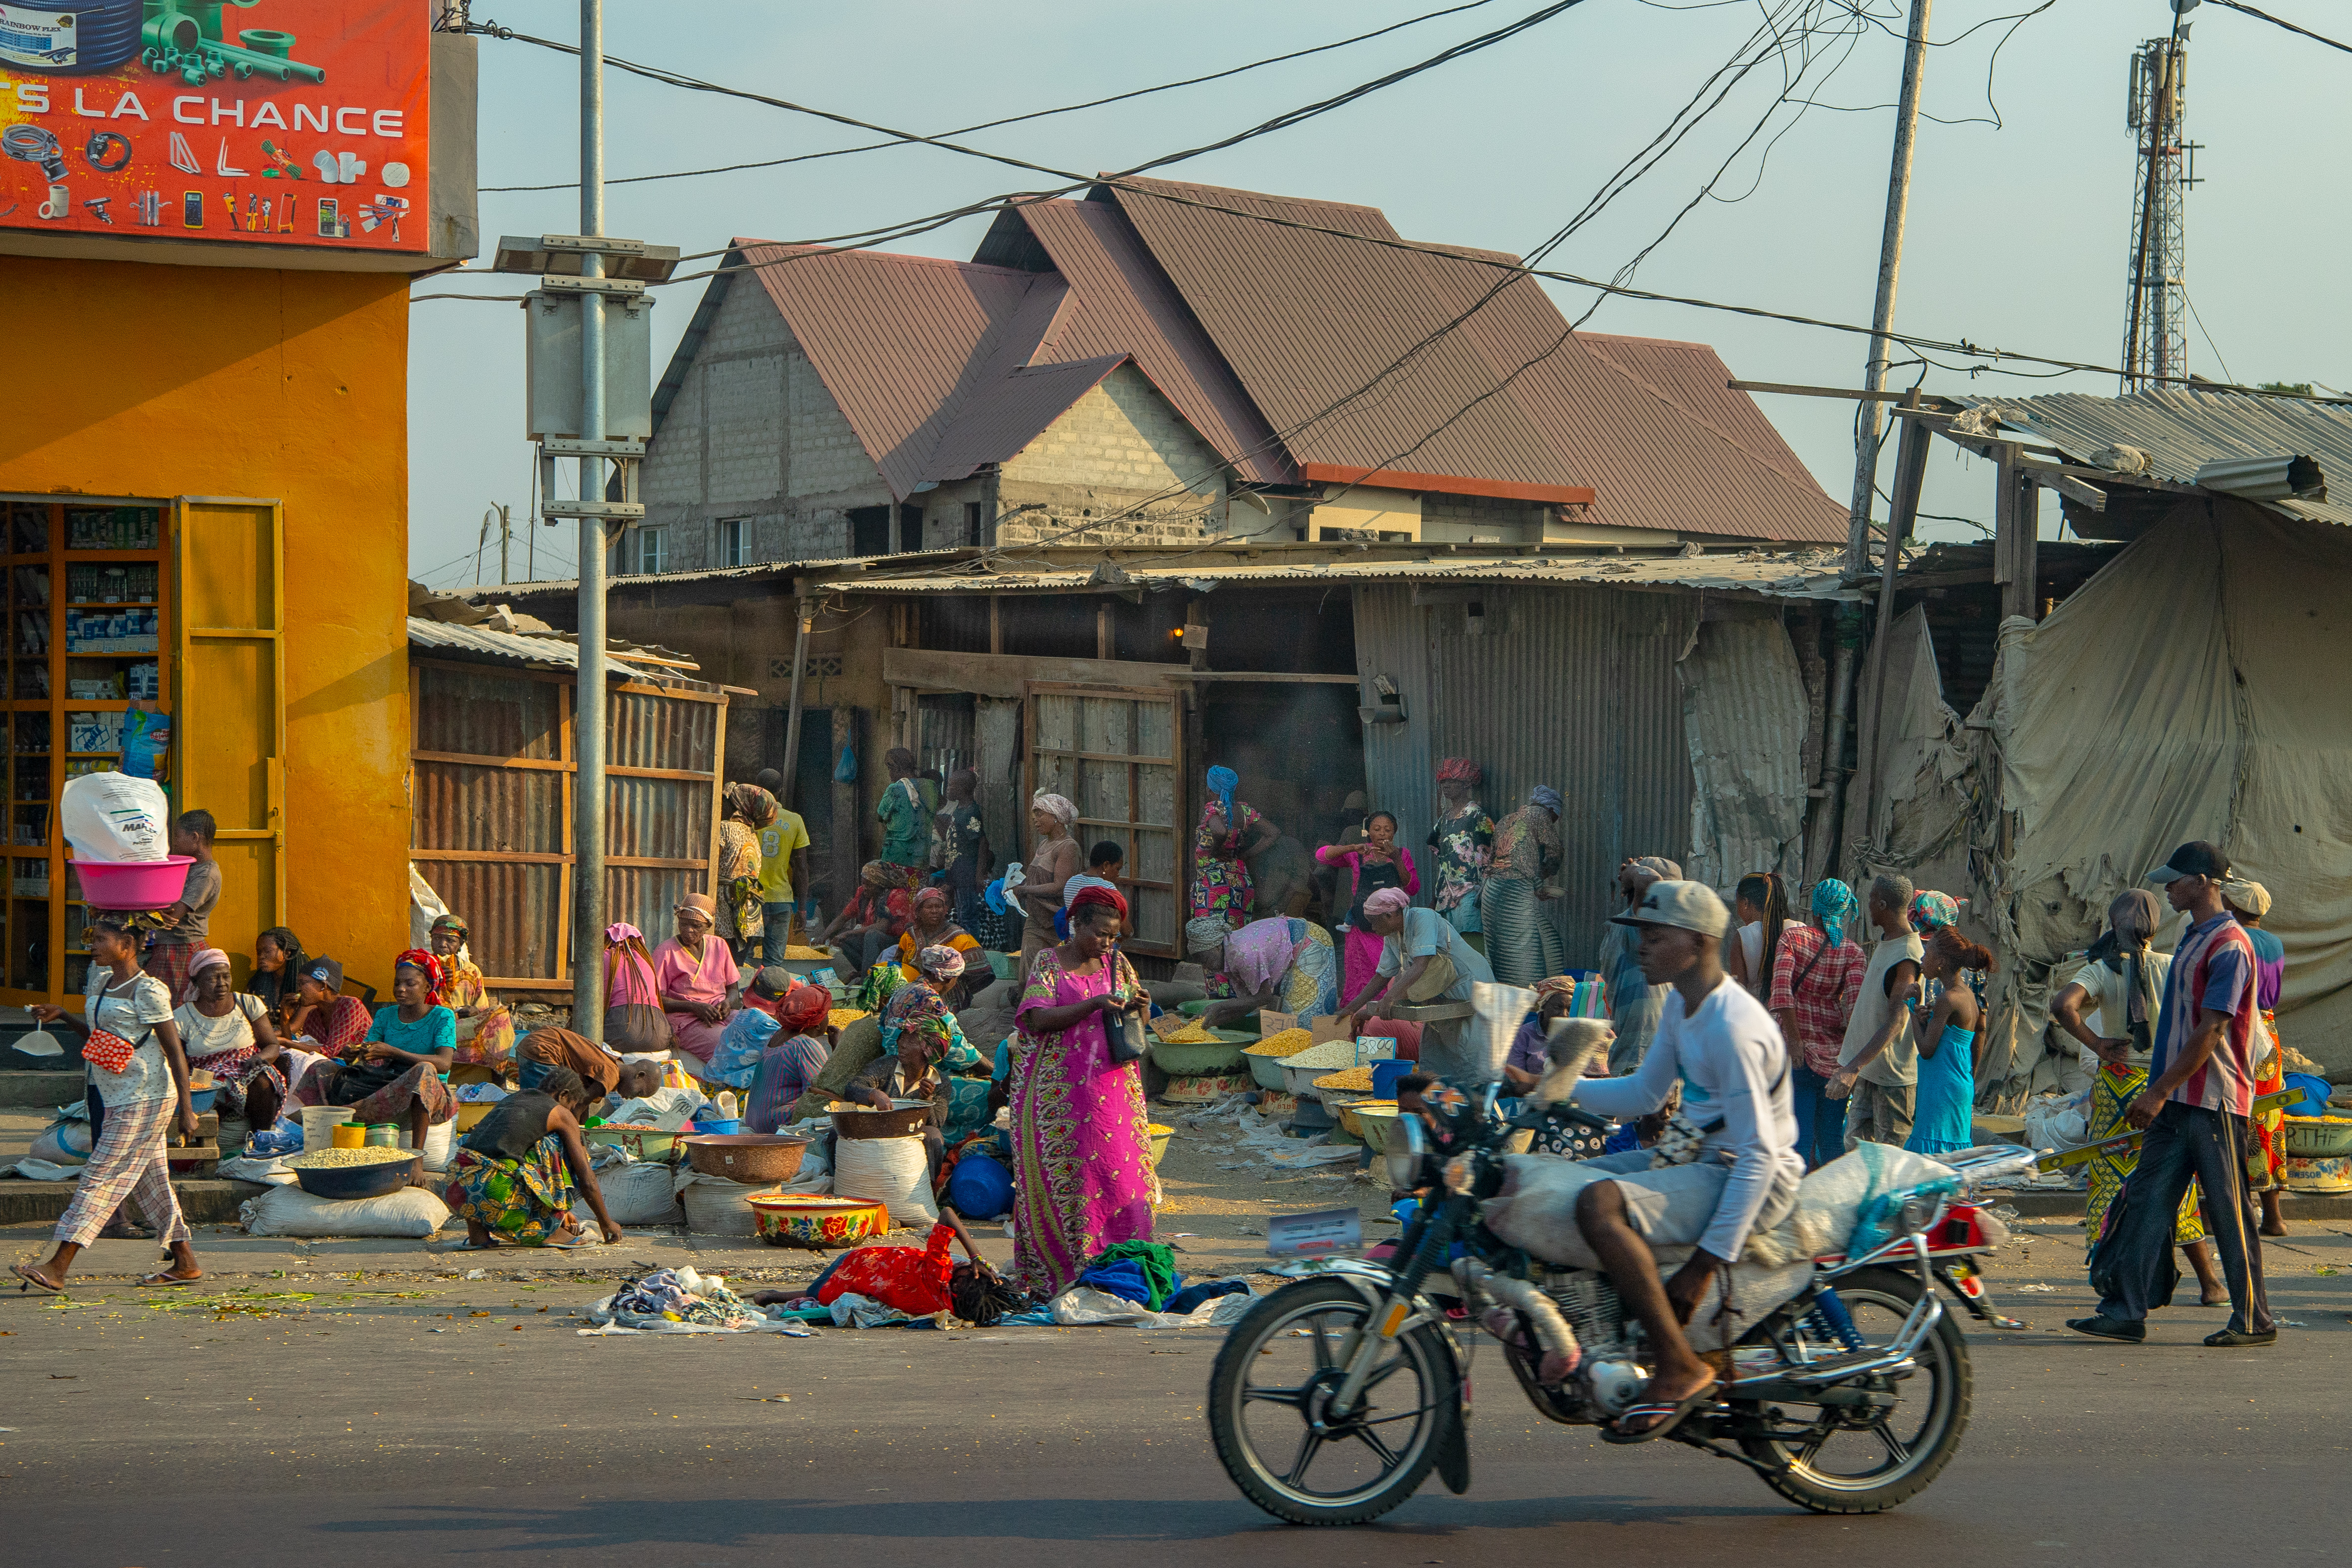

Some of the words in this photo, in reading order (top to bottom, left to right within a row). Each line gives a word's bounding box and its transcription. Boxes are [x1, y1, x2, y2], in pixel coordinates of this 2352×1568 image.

[75, 88, 149, 121] LA
[174, 95, 403, 138] CHANCE
[762, 830, 780, 857] 8
[1358, 1037, 1393, 1055] 3800
